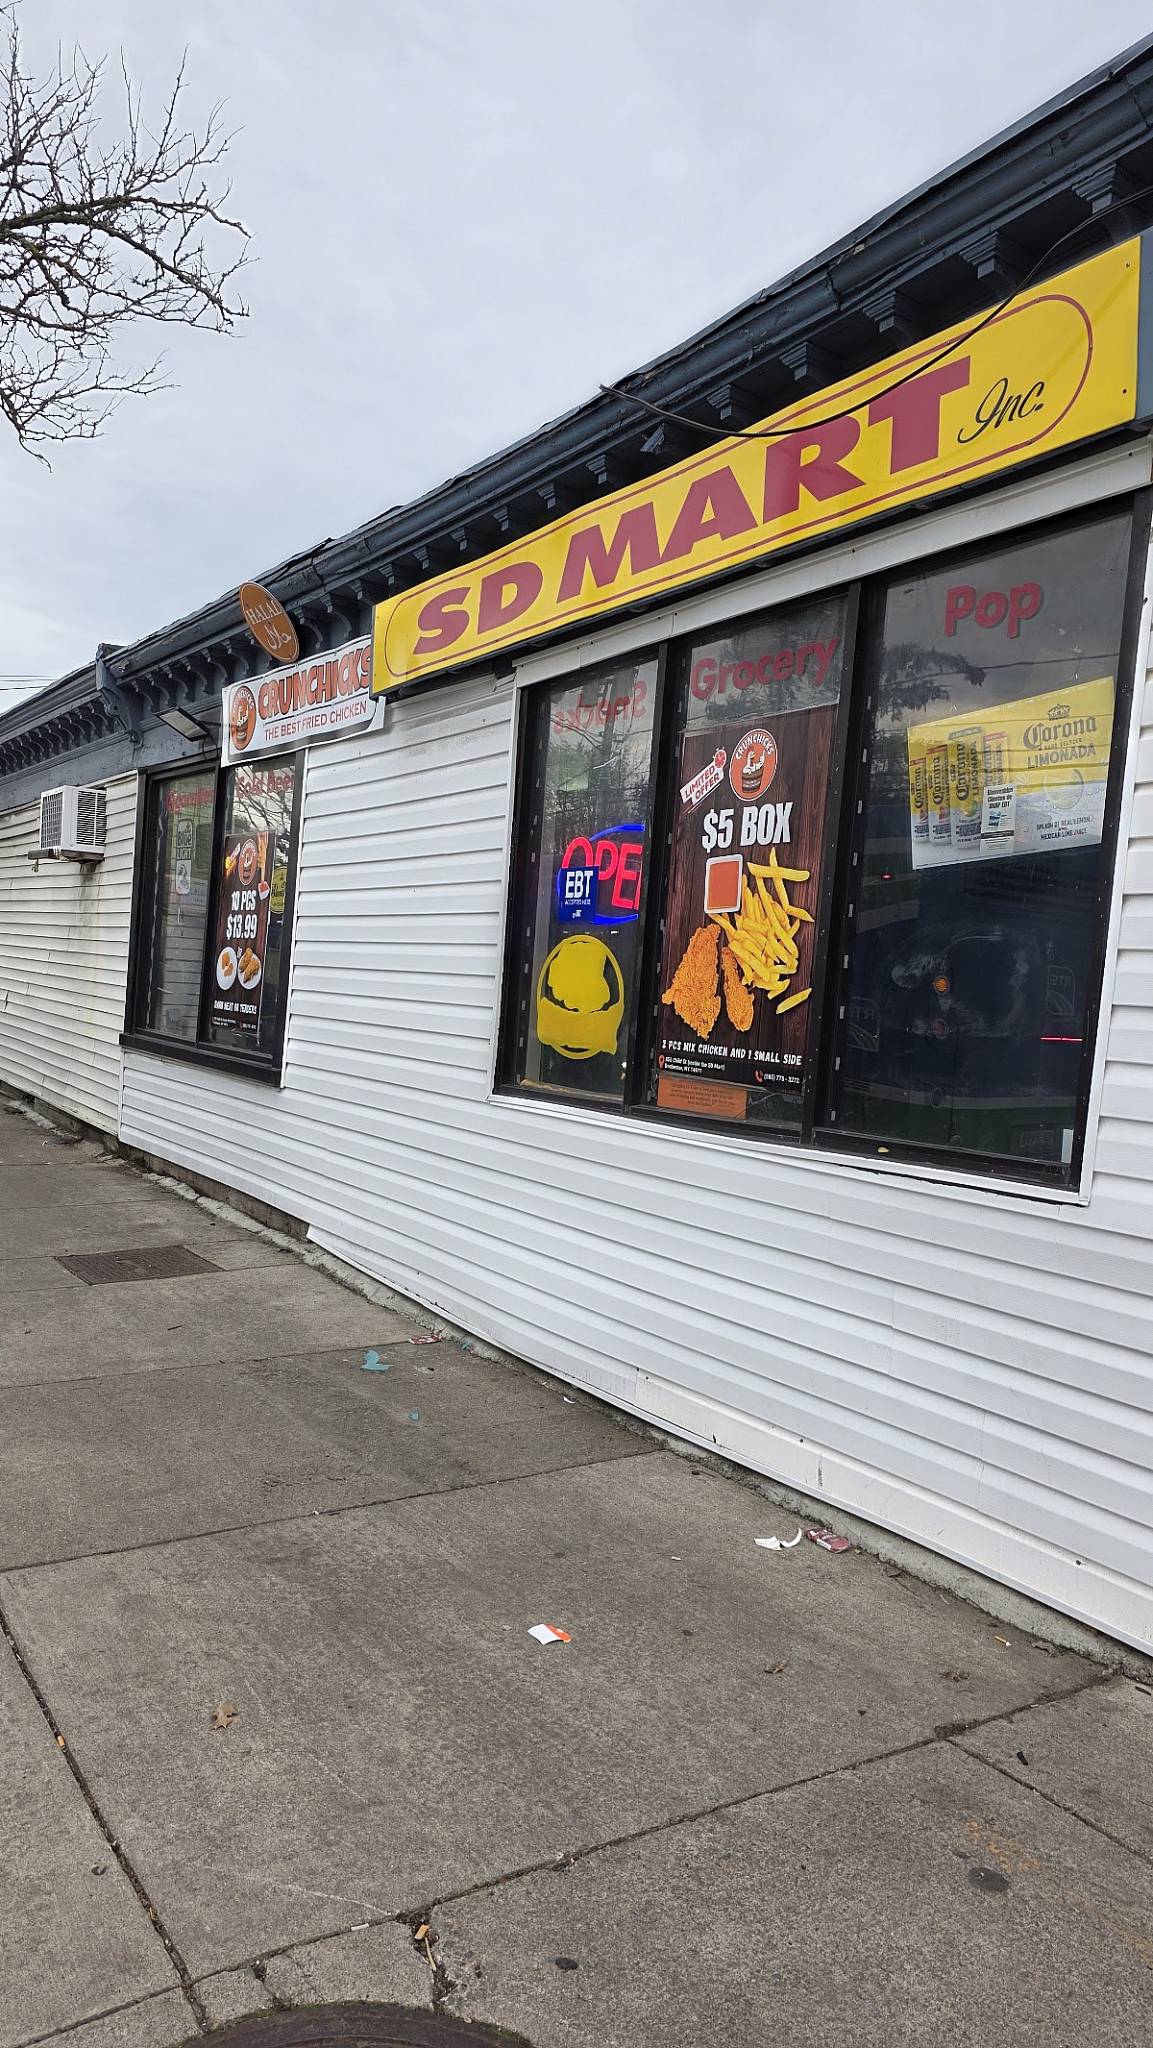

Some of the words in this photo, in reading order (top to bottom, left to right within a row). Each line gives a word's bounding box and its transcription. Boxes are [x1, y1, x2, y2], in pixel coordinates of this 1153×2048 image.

[414, 560, 543, 655] SD
[557, 357, 972, 604] MART
[957, 377, 1046, 444] Inc.
[245, 600, 281, 624] HALAL
[944, 581, 1044, 638] Pop
[258, 644, 372, 720] CRUNCHICKS
[691, 638, 841, 700] Grocery
[264, 724, 280, 741] THE
[281, 722, 300, 738] BEST
[302, 714, 327, 732] FRIED
[330, 701, 367, 724] CHICKEN
[1023, 716, 1097, 750] Corona
[735, 733, 774, 759] CRUNCHICKS
[1028, 744, 1096, 769] LIMONADA
[684, 765, 715, 799] LIMITED
[694, 773, 720, 800] OFFER
[915, 767, 924, 808] Corona
[933, 755, 944, 805] Corona
[956, 743, 969, 801] Corona
[702, 808, 734, 854] $5
[740, 801, 794, 847] BOX
[231, 891, 240, 911] 10
[241, 890, 257, 911] PCS
[565, 870, 594, 899] EBT
[226, 914, 258, 941] $13.99
[662, 1040, 666, 1049] 2
[668, 1040, 681, 1050] PCS
[683, 1042, 695, 1052] MIX
[698, 1043, 728, 1057] CHICKEN
[730, 1049, 746, 1059] AND
[754, 1050, 780, 1063] SMALL
[783, 1053, 802, 1066] SIDE
